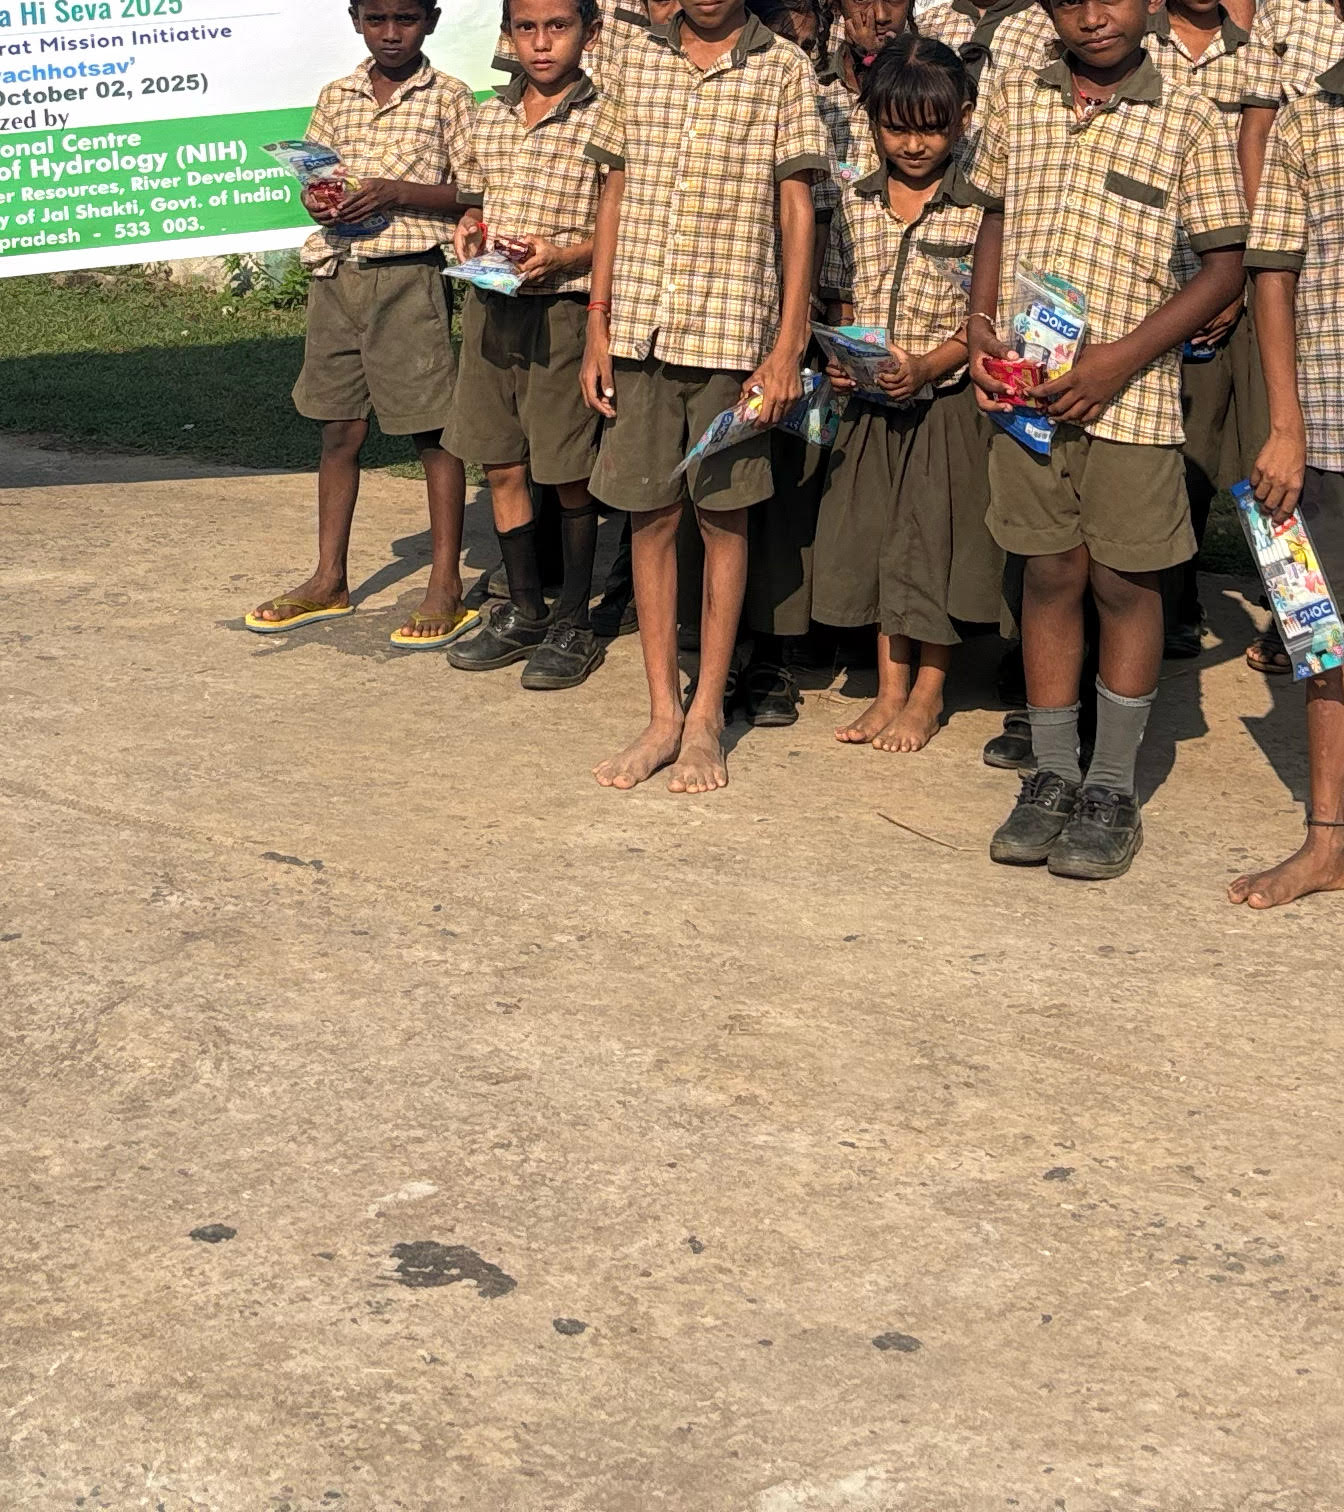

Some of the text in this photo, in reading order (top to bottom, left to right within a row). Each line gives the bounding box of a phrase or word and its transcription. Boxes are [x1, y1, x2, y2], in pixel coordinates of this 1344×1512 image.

[21, 2, 47, 27] Hi
[40, 33, 124, 52] Mission
[132, 24, 233, 45] Initiative
[96, 81, 133, 100] 02,
[141, 73, 209, 96] 2025)
[43, 110, 70, 132] by
[62, 132, 142, 153] Centre
[30, 149, 167, 181] Hydrology
[176, 140, 248, 170] (NIH)
[21, 181, 125, 203] Resources,
[131, 175, 181, 192] River
[15, 208, 36, 225] of
[40, 203, 70, 223] Jal
[76, 199, 145, 221] Shakti,
[150, 193, 203, 212] Govt.
[209, 189, 229, 207] of
[234, 185, 292, 205] India)
[115, 222, 151, 239] 533
[162, 217, 206, 234] 003.
[1039, 310, 1078, 338] DOMS
